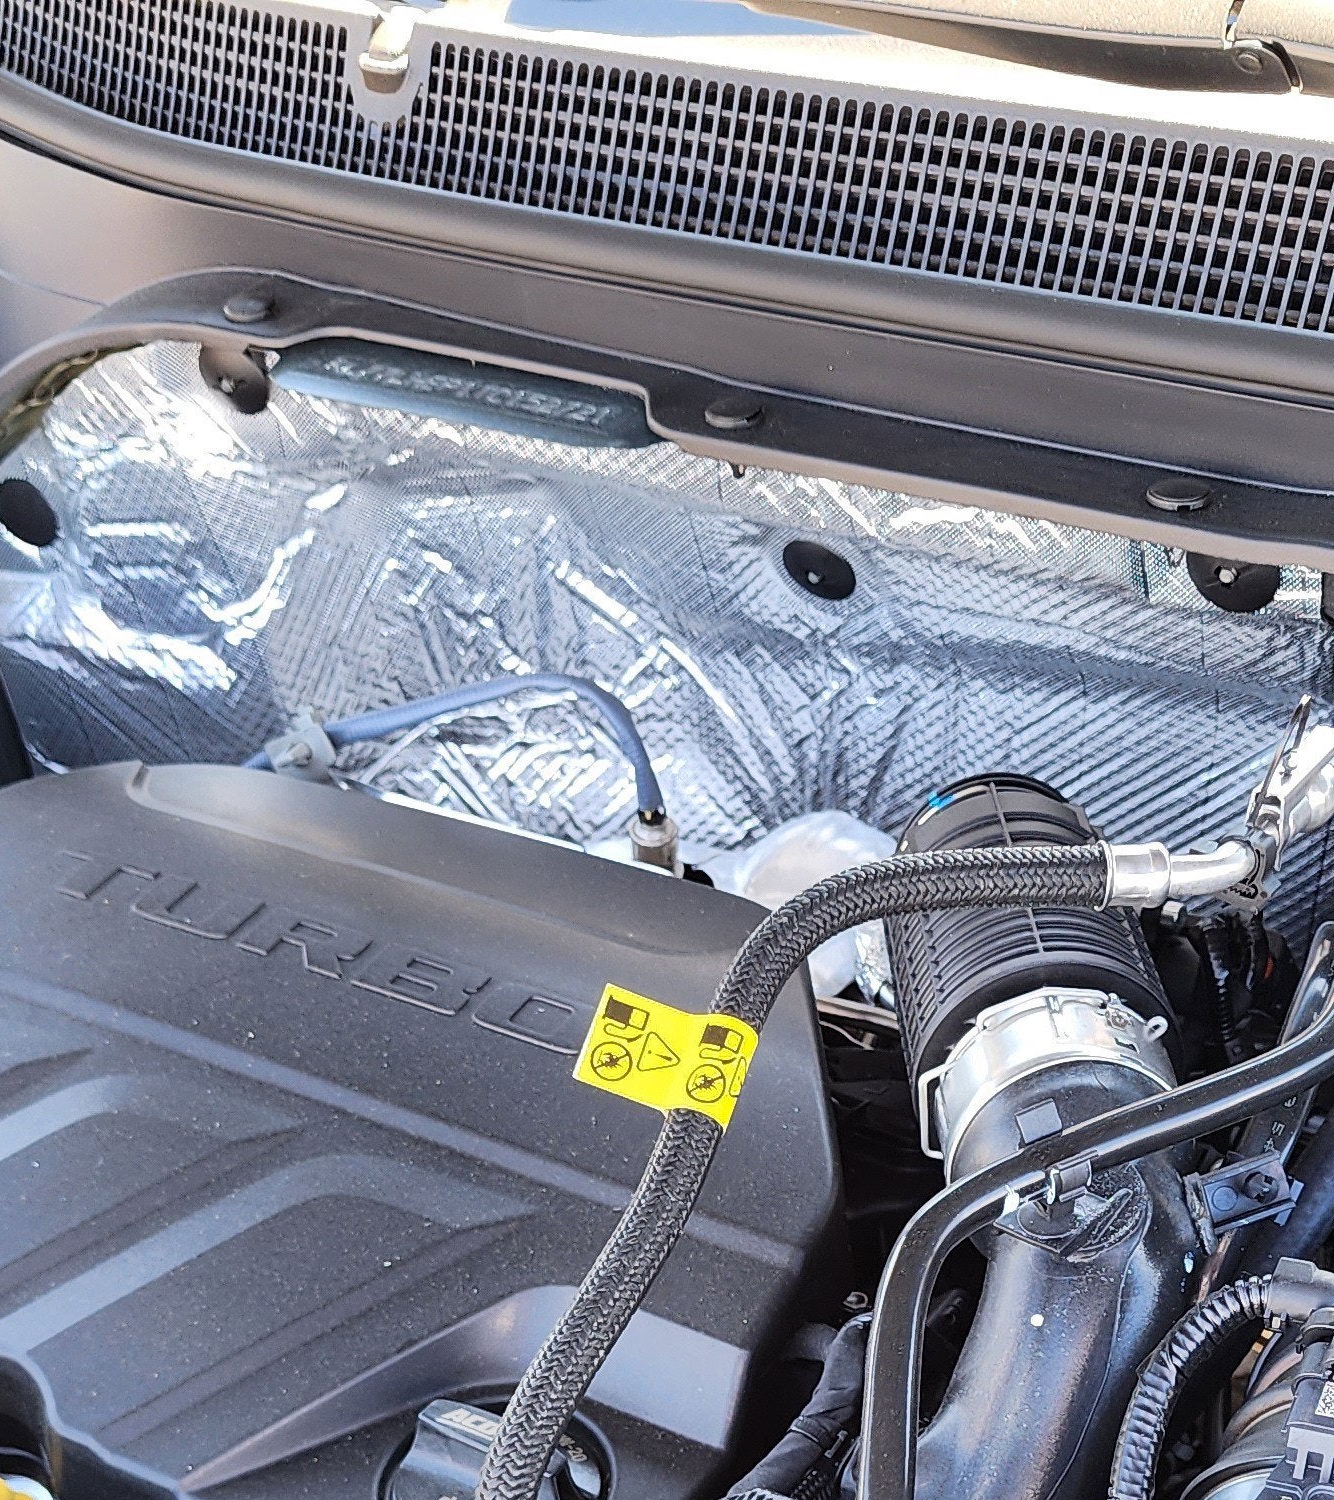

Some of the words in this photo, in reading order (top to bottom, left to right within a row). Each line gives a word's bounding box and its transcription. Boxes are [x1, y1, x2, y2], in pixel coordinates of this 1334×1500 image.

[54, 848, 598, 1058] TURBO
[440, 1402, 502, 1438] ACD
[557, 1433, 589, 1465] W-20
